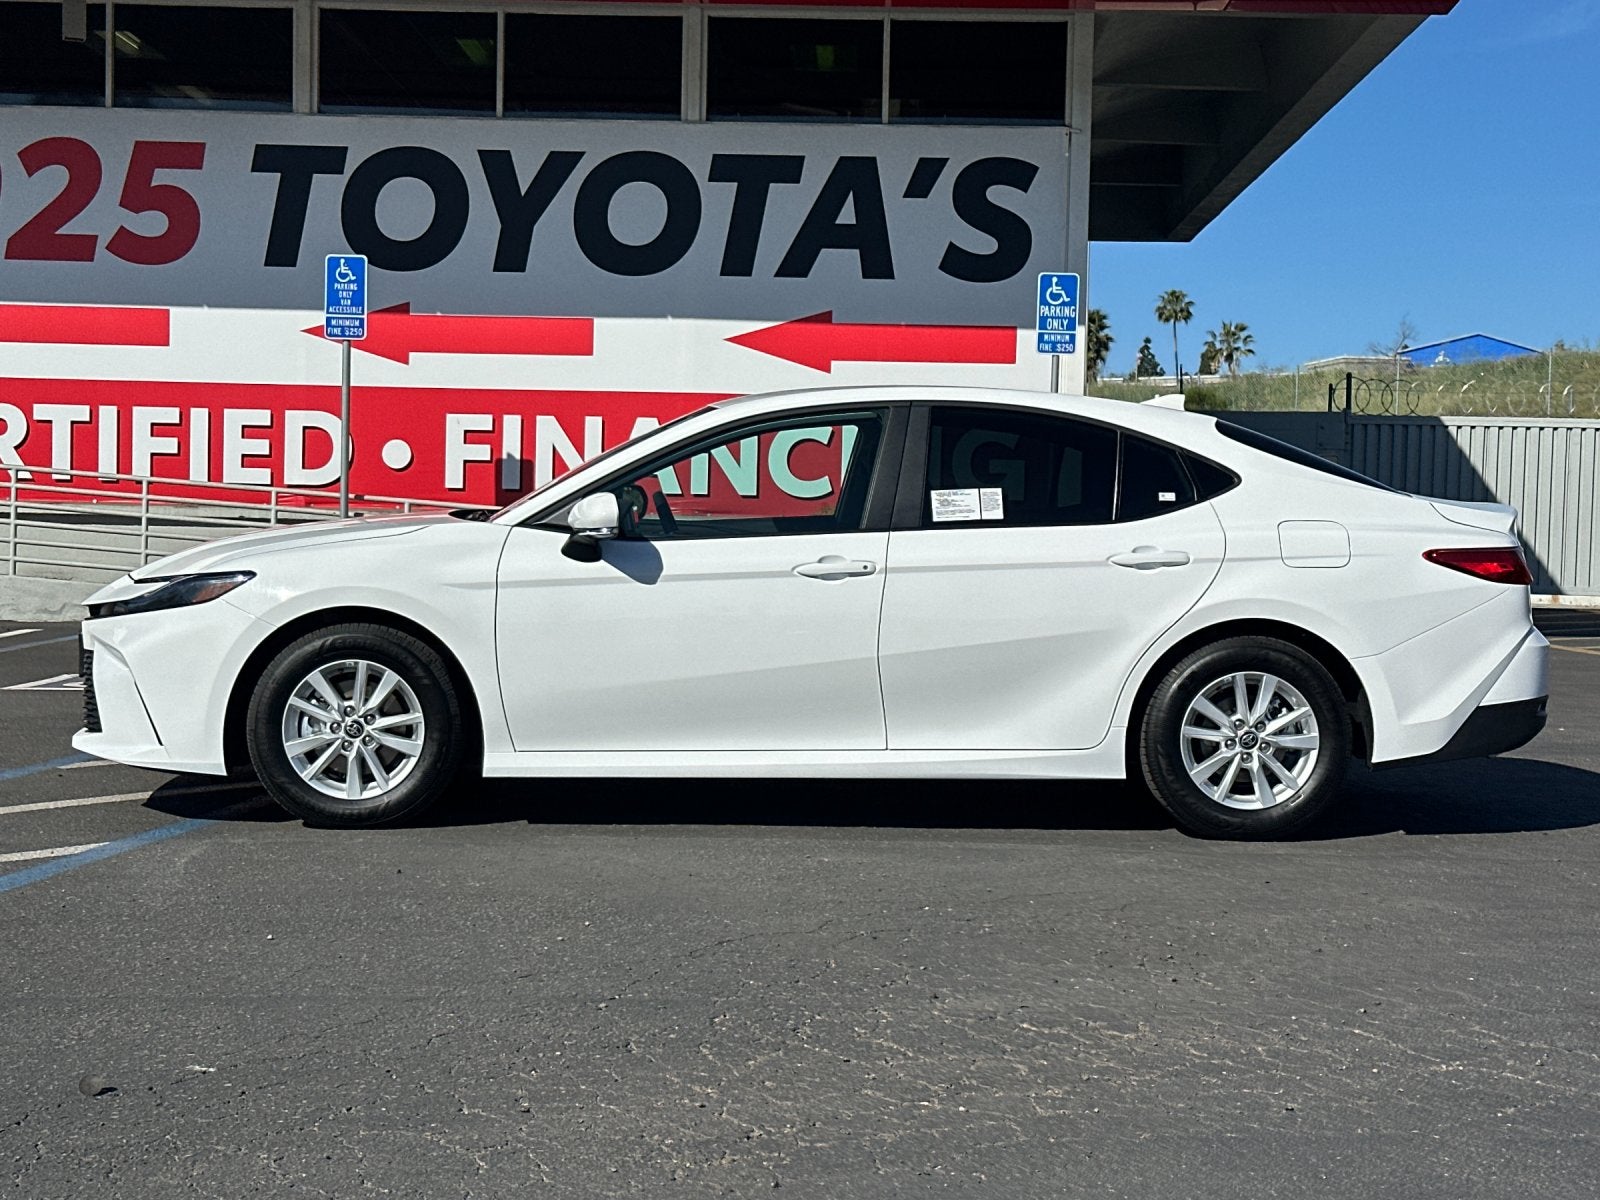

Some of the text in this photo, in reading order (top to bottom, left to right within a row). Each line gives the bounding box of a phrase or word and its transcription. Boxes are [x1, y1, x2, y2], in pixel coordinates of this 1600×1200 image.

[0, 136, 1040, 283] 25 TOYOTA'S
[334, 283, 358, 291] PARKING
[340, 298, 351, 306] VAN
[328, 306, 363, 314] ACCESSIBLE
[1040, 305, 1076, 318] PARKING
[331, 319, 360, 327] MINIMUM
[1046, 318, 1069, 330] ONLY
[327, 327, 363, 336] FINE $250
[1043, 334, 1070, 342] MINIMUM
[1039, 343, 1074, 352] FINE $250
